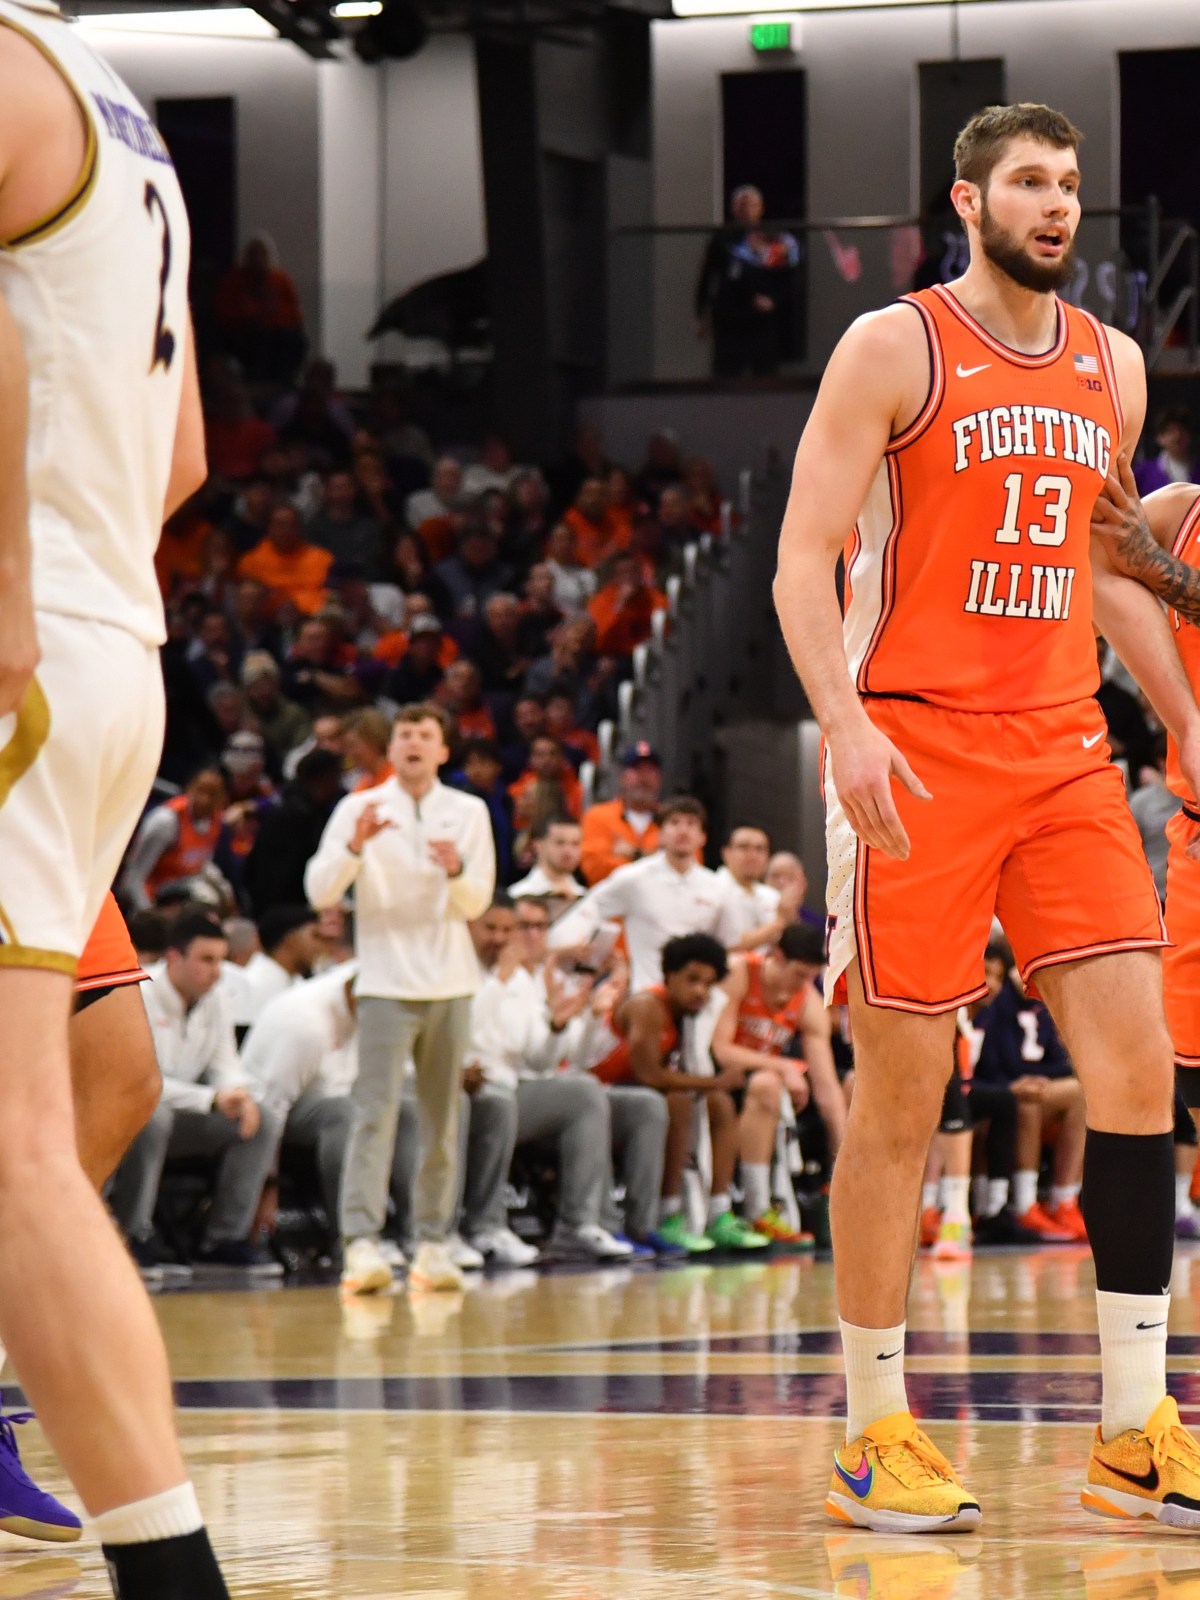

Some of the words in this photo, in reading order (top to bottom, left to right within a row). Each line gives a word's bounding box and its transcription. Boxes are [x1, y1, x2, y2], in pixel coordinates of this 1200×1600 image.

[953, 404, 1111, 480] FIGHTING
[995, 473, 1073, 547] 13
[964, 559, 1076, 620] ILLINI
